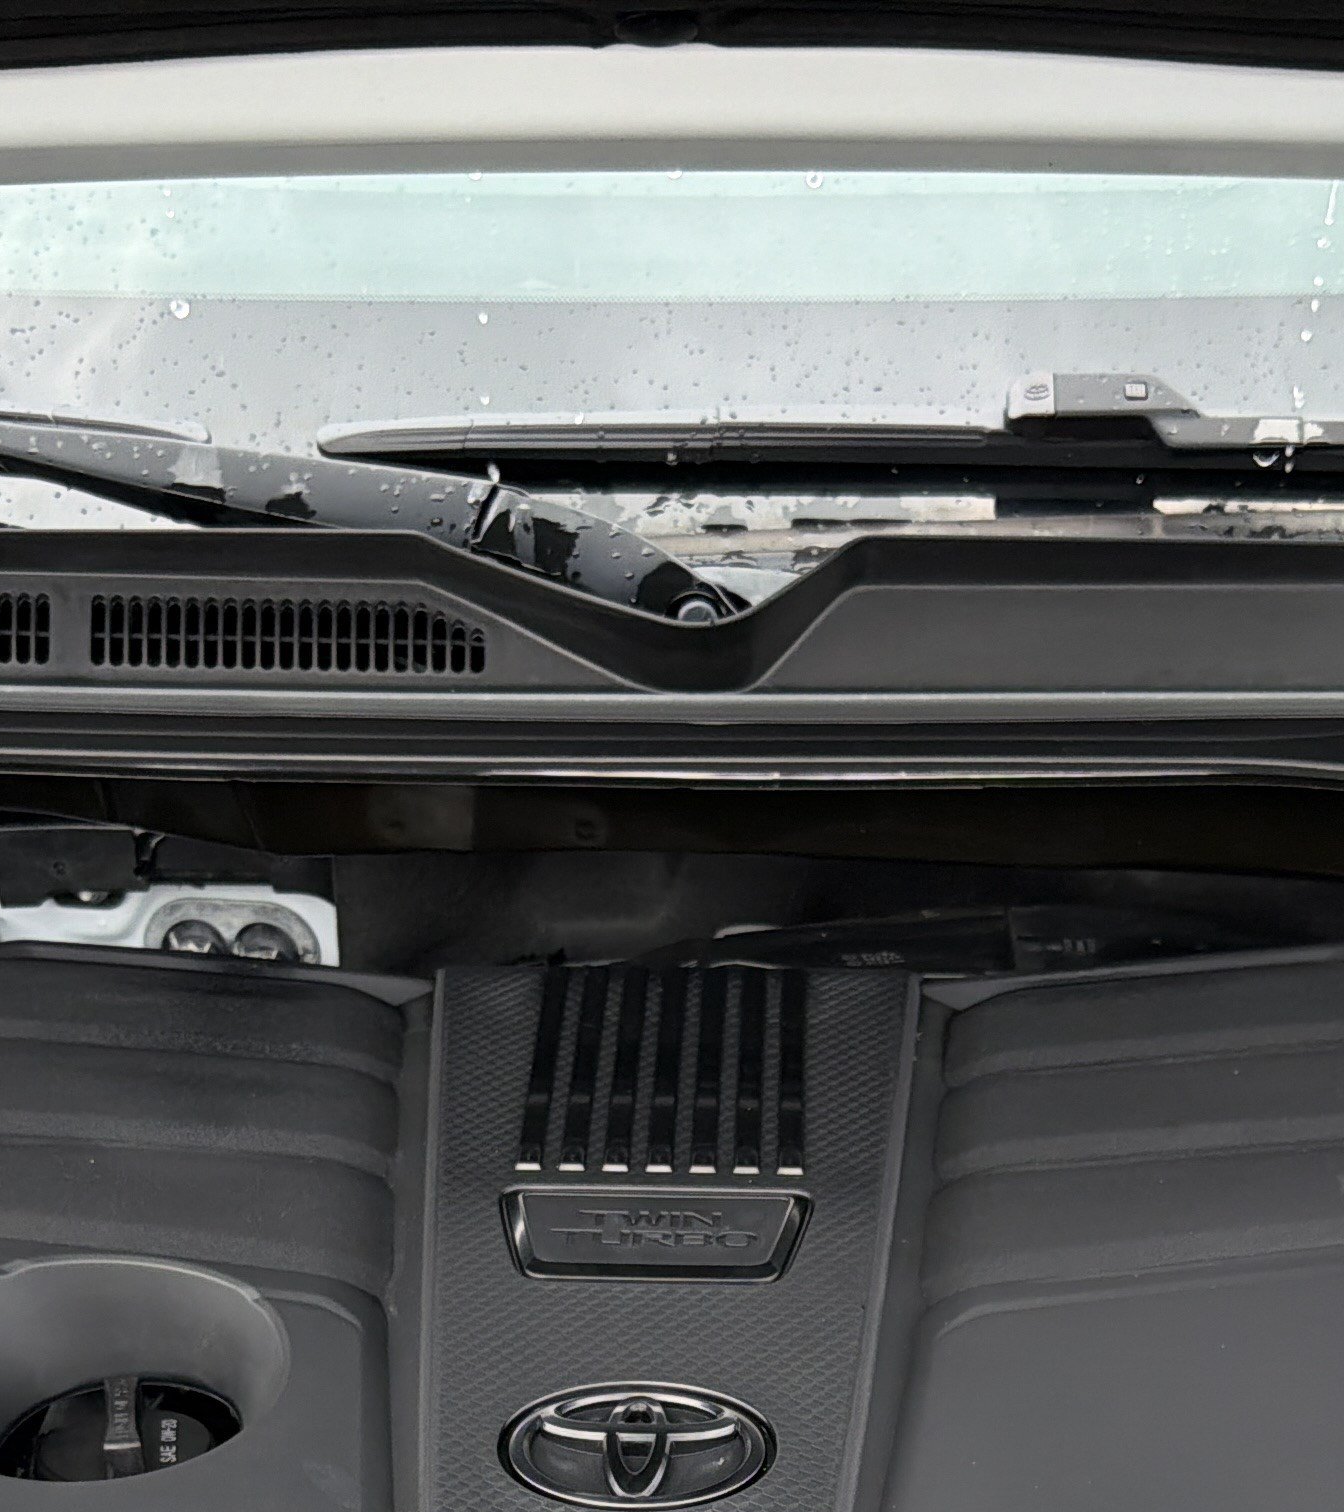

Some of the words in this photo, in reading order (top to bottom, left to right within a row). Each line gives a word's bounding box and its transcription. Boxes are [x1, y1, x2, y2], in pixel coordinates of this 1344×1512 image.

[578, 1209, 723, 1227] TWIN
[550, 1227, 759, 1248] TURBO
[159, 1446, 177, 1463] SAE
